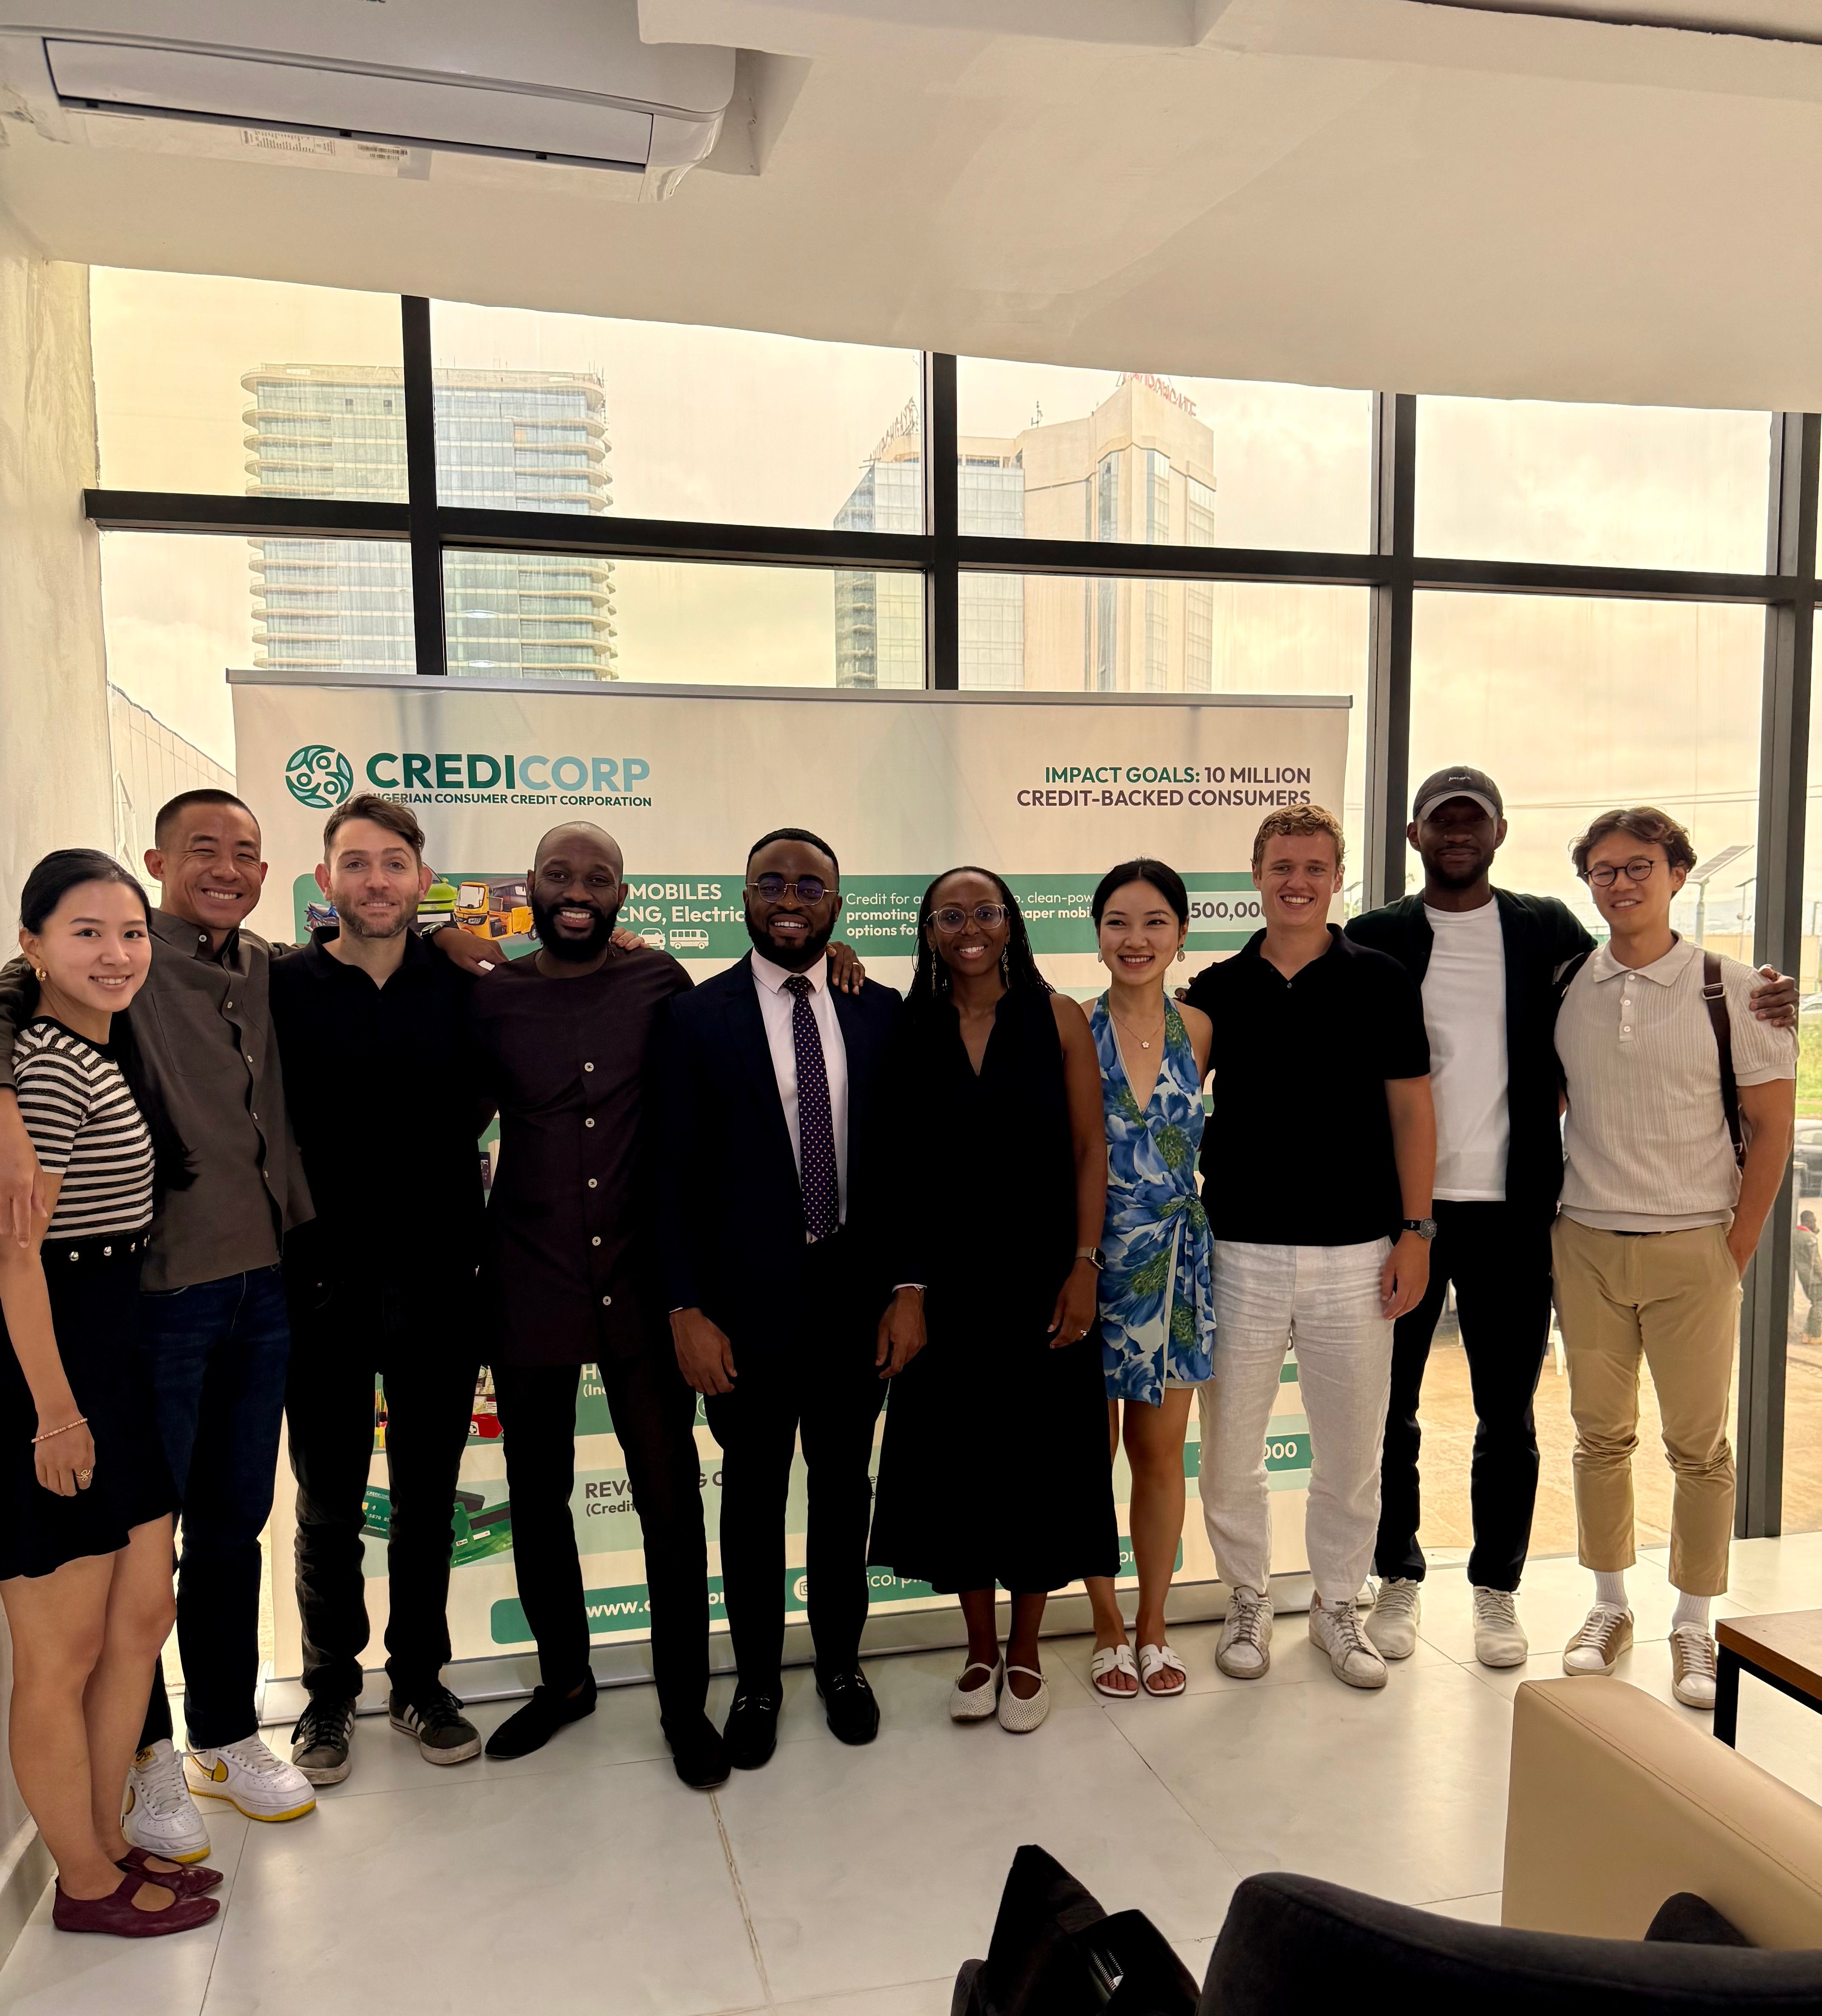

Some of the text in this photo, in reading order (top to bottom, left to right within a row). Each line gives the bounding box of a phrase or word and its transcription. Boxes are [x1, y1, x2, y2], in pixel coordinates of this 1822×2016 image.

[366, 752, 650, 792] CREDICORP
[1045, 766, 1311, 784] IMPACT GOALS: 10 MILLION
[435, 793, 508, 803] CONSUMER
[511, 794, 557, 805] CREDIT
[560, 796, 652, 806] CORPORATION
[1017, 789, 1311, 806] CREDIT-BACKED CONSUMERS
[846, 893, 887, 905] Credit
[890, 893, 910, 904] for
[672, 906, 746, 922] Electric
[846, 909, 917, 923] promoting
[1191, 901, 1266, 921] 500,00
[846, 924, 897, 939] options
